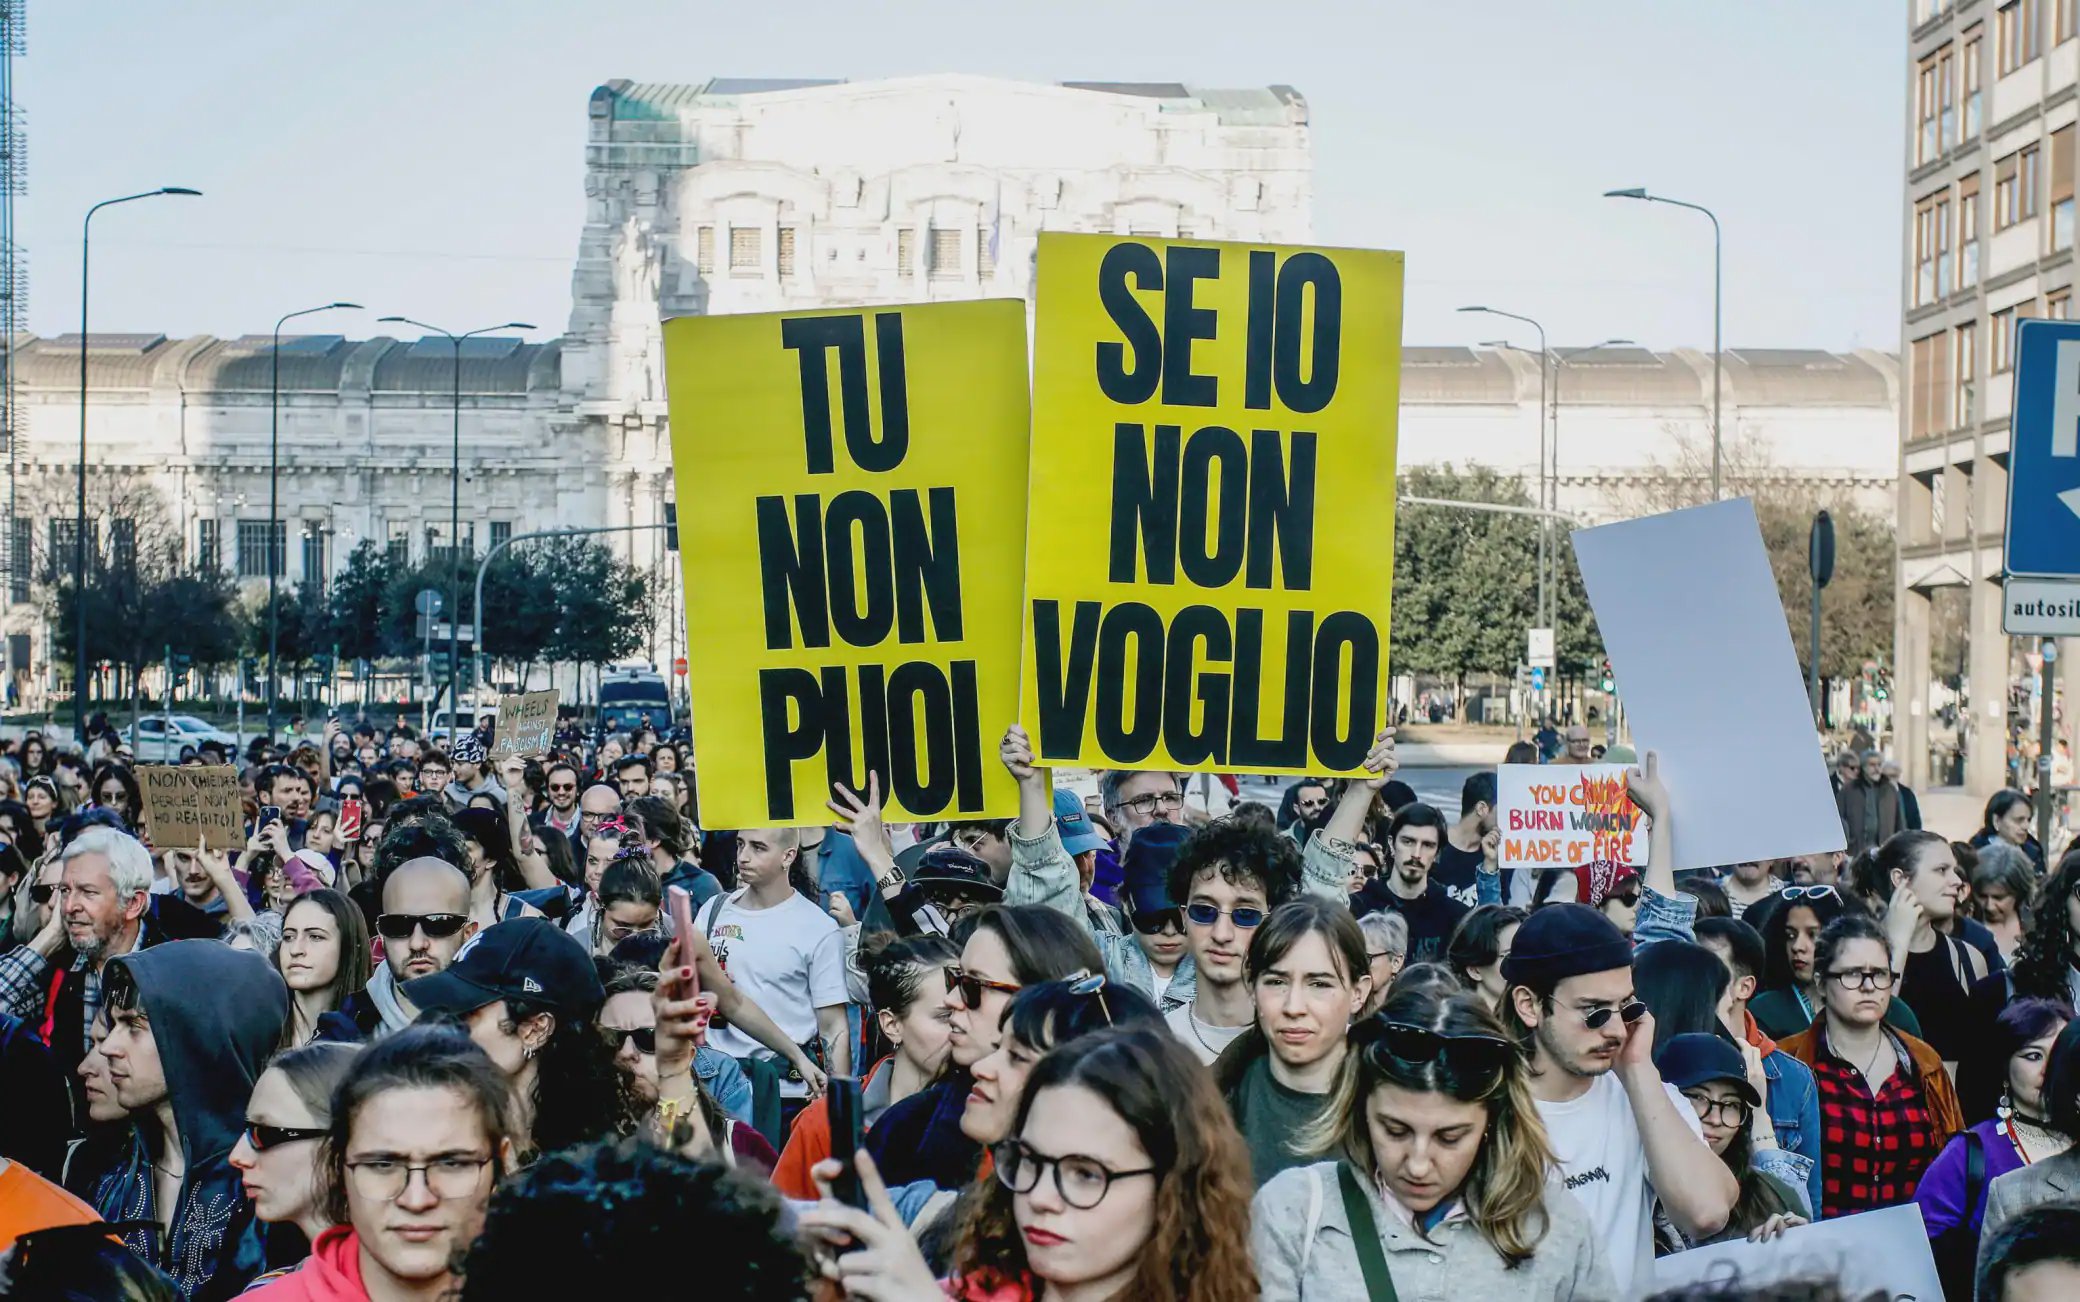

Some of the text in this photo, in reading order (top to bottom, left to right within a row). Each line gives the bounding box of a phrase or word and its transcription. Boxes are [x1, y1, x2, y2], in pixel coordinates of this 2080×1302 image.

[1097, 243, 1341, 413] SE IO
[781, 313, 908, 474] TU
[1109, 423, 1316, 590] NON
[756, 487, 964, 650] NON
[1033, 599, 1379, 771] VOGLIO
[506, 699, 548, 719] WHEELS
[759, 660, 984, 824] PUOI
[149, 772, 186, 788] NON
[1529, 784, 1566, 804] YOU
[204, 794, 228, 807] NON
[154, 811, 169, 824] HO
[1509, 809, 1631, 831] BURN WOMEN
[1504, 833, 1633, 863] MADE OF FIRE
